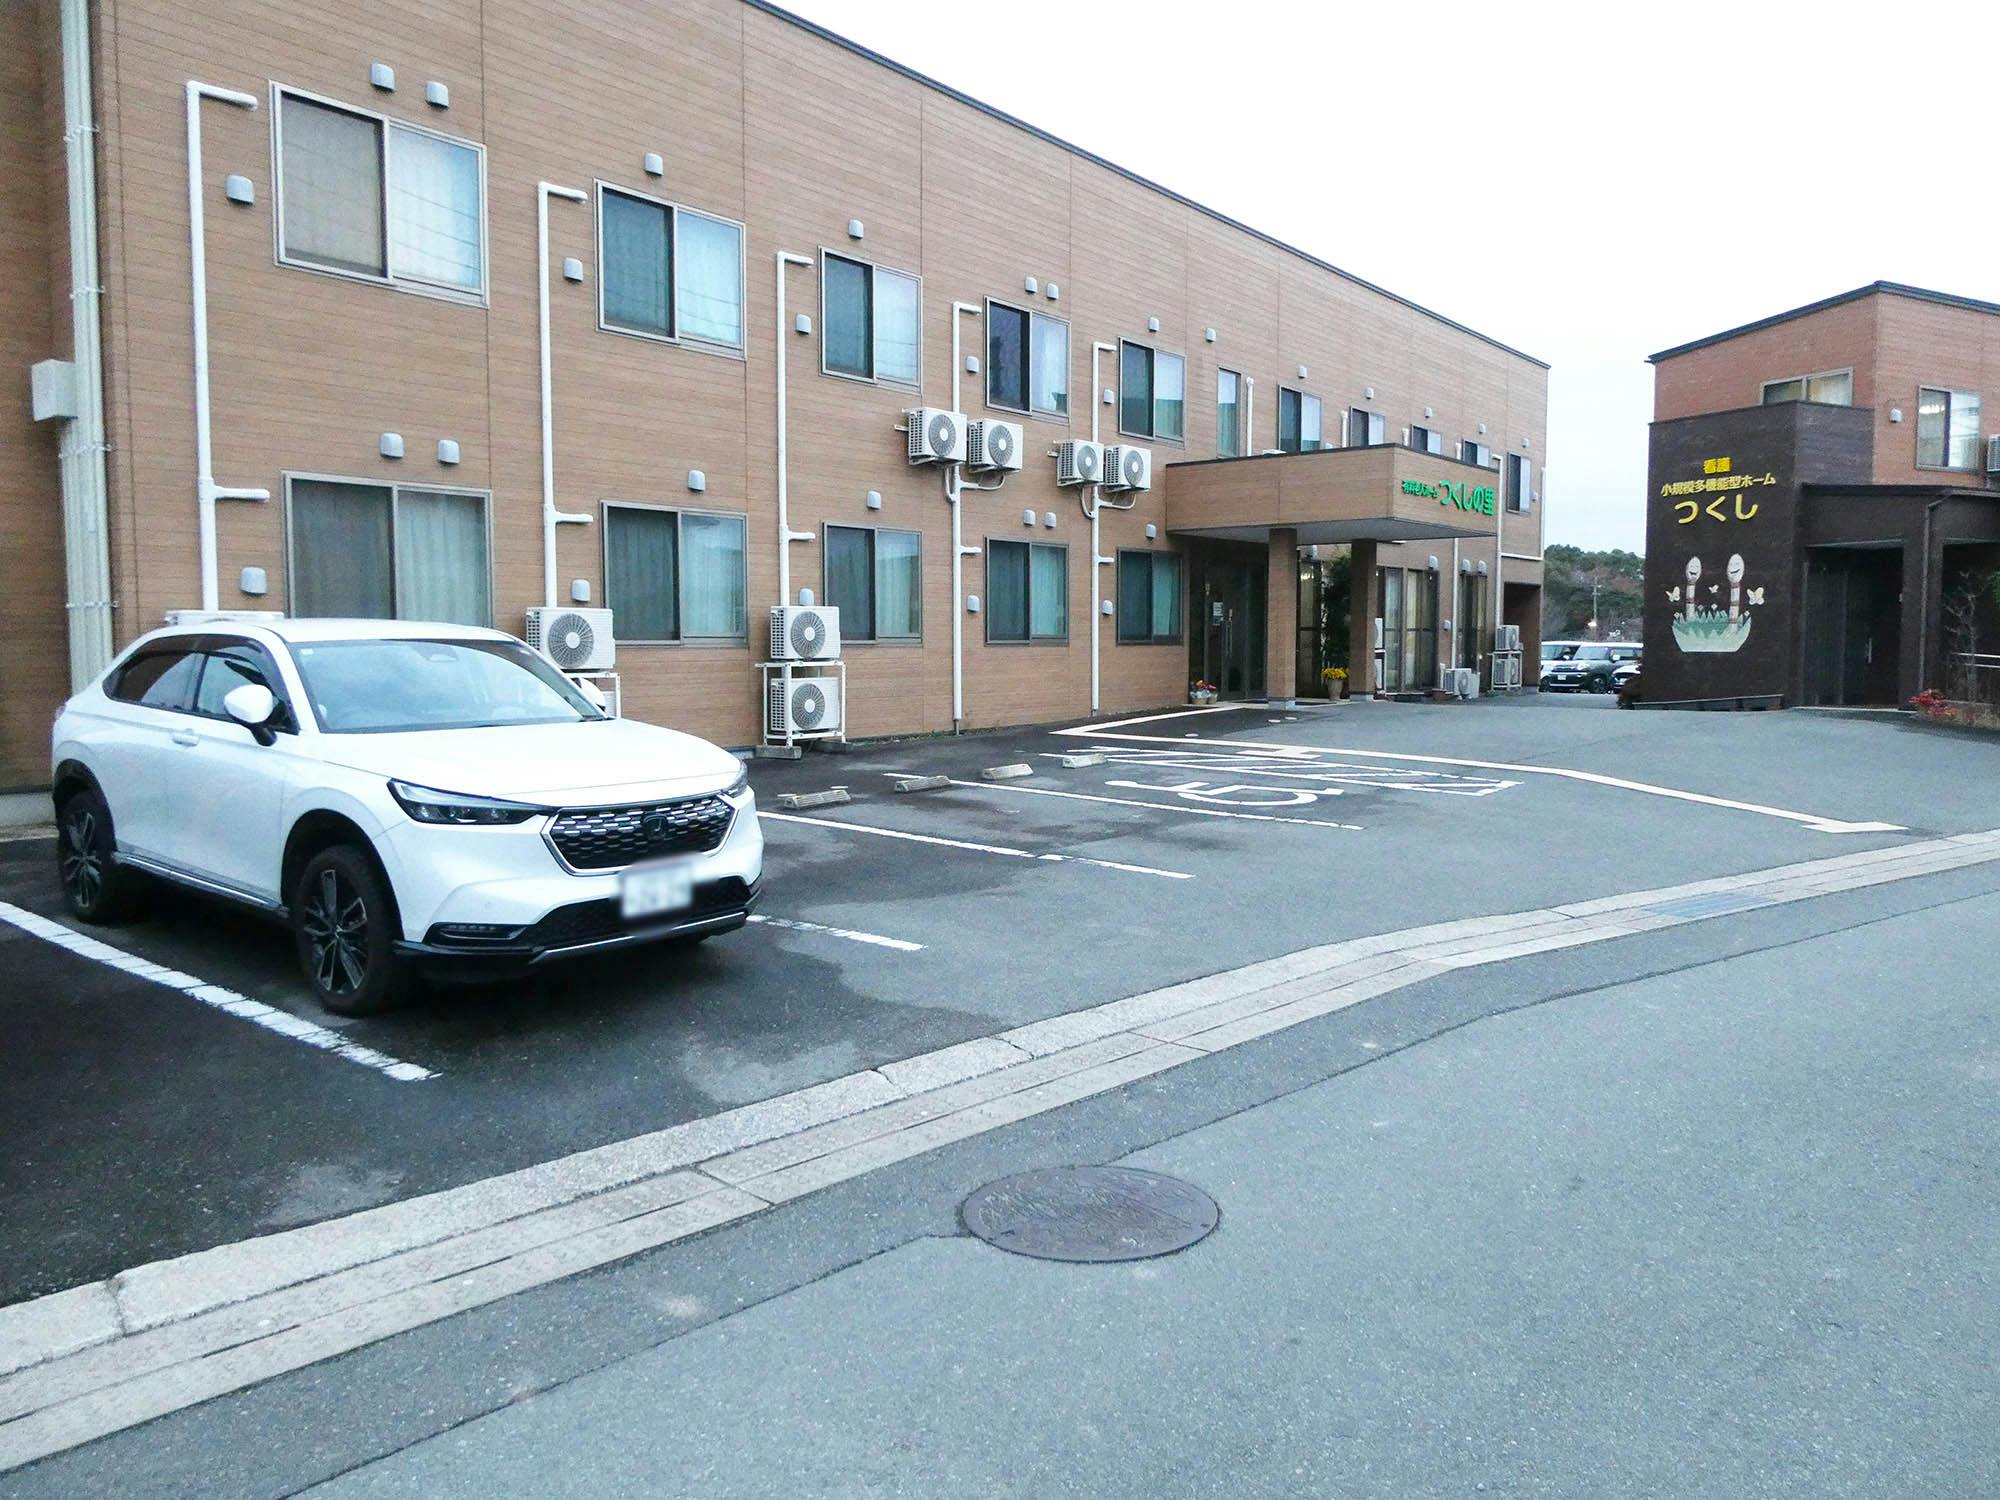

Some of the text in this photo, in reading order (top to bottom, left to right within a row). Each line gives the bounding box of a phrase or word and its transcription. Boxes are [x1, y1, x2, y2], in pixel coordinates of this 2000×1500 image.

[1439, 480, 1495, 516] つくしの里
[1661, 473, 1776, 496] 小規模多機能型ホーム
[1674, 494, 1758, 524] つくし
